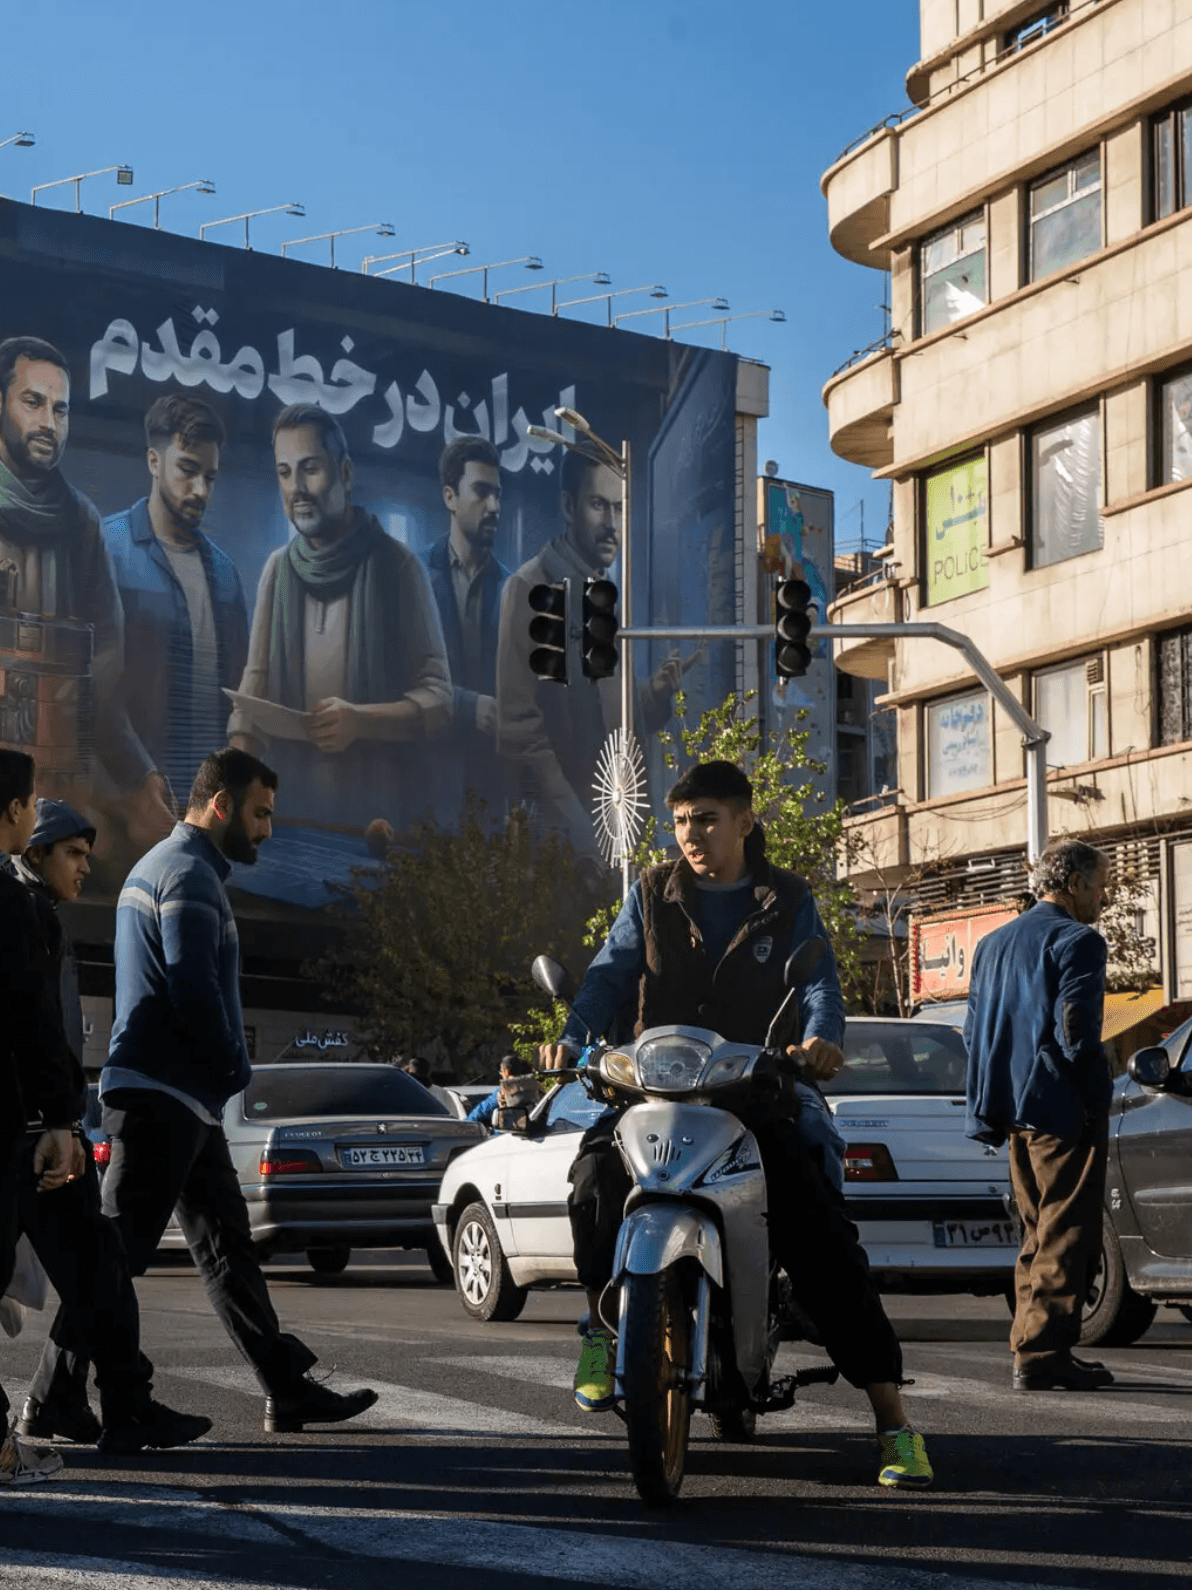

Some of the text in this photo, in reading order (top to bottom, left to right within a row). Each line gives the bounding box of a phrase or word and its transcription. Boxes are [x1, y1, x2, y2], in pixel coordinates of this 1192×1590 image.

[89, 304, 576, 475] ایران در خط مقدم
[933, 543, 989, 586] POLICE
[318, 1032, 348, 1049] کفش
